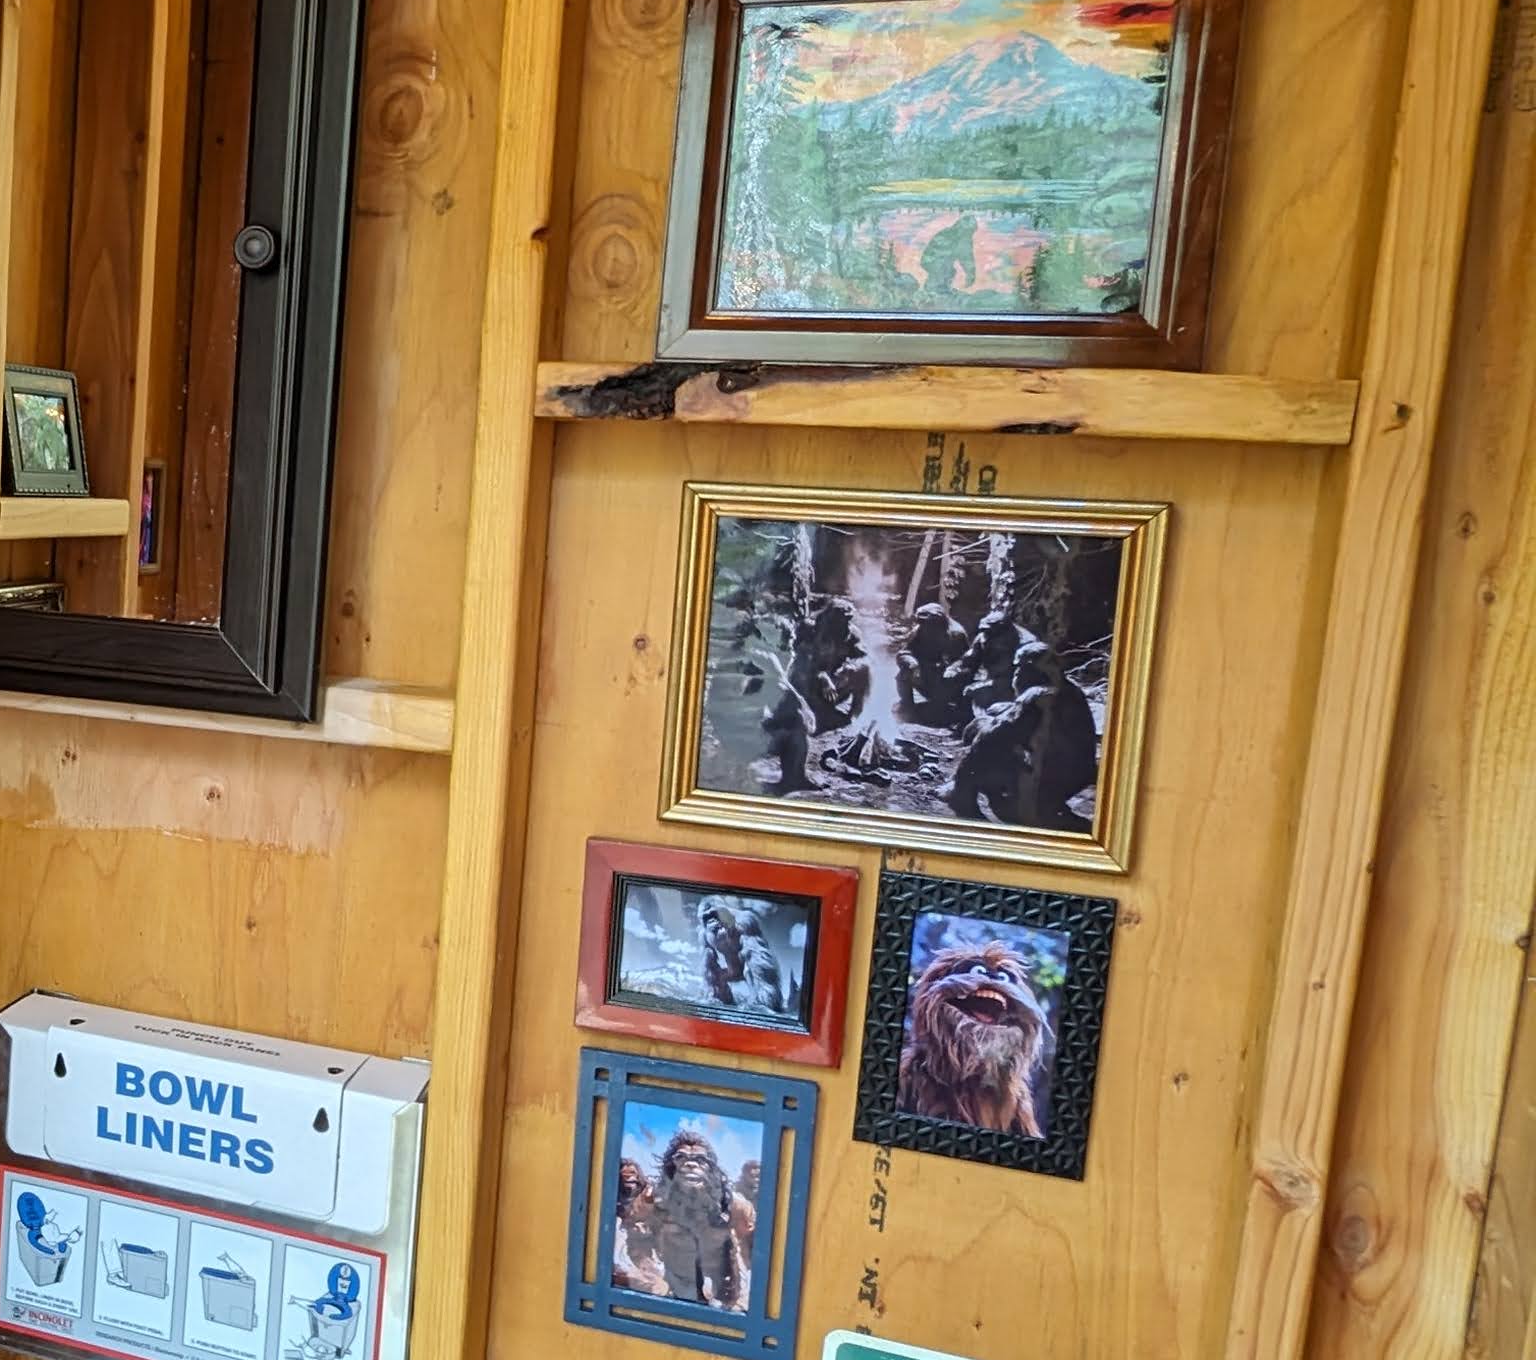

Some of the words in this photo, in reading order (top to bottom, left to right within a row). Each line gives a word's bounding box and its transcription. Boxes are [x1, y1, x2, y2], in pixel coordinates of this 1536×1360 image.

[171, 1028, 220, 1040] PUNCH
[115, 1061, 258, 1123] BOWL
[96, 1106, 275, 1175] LINERS
